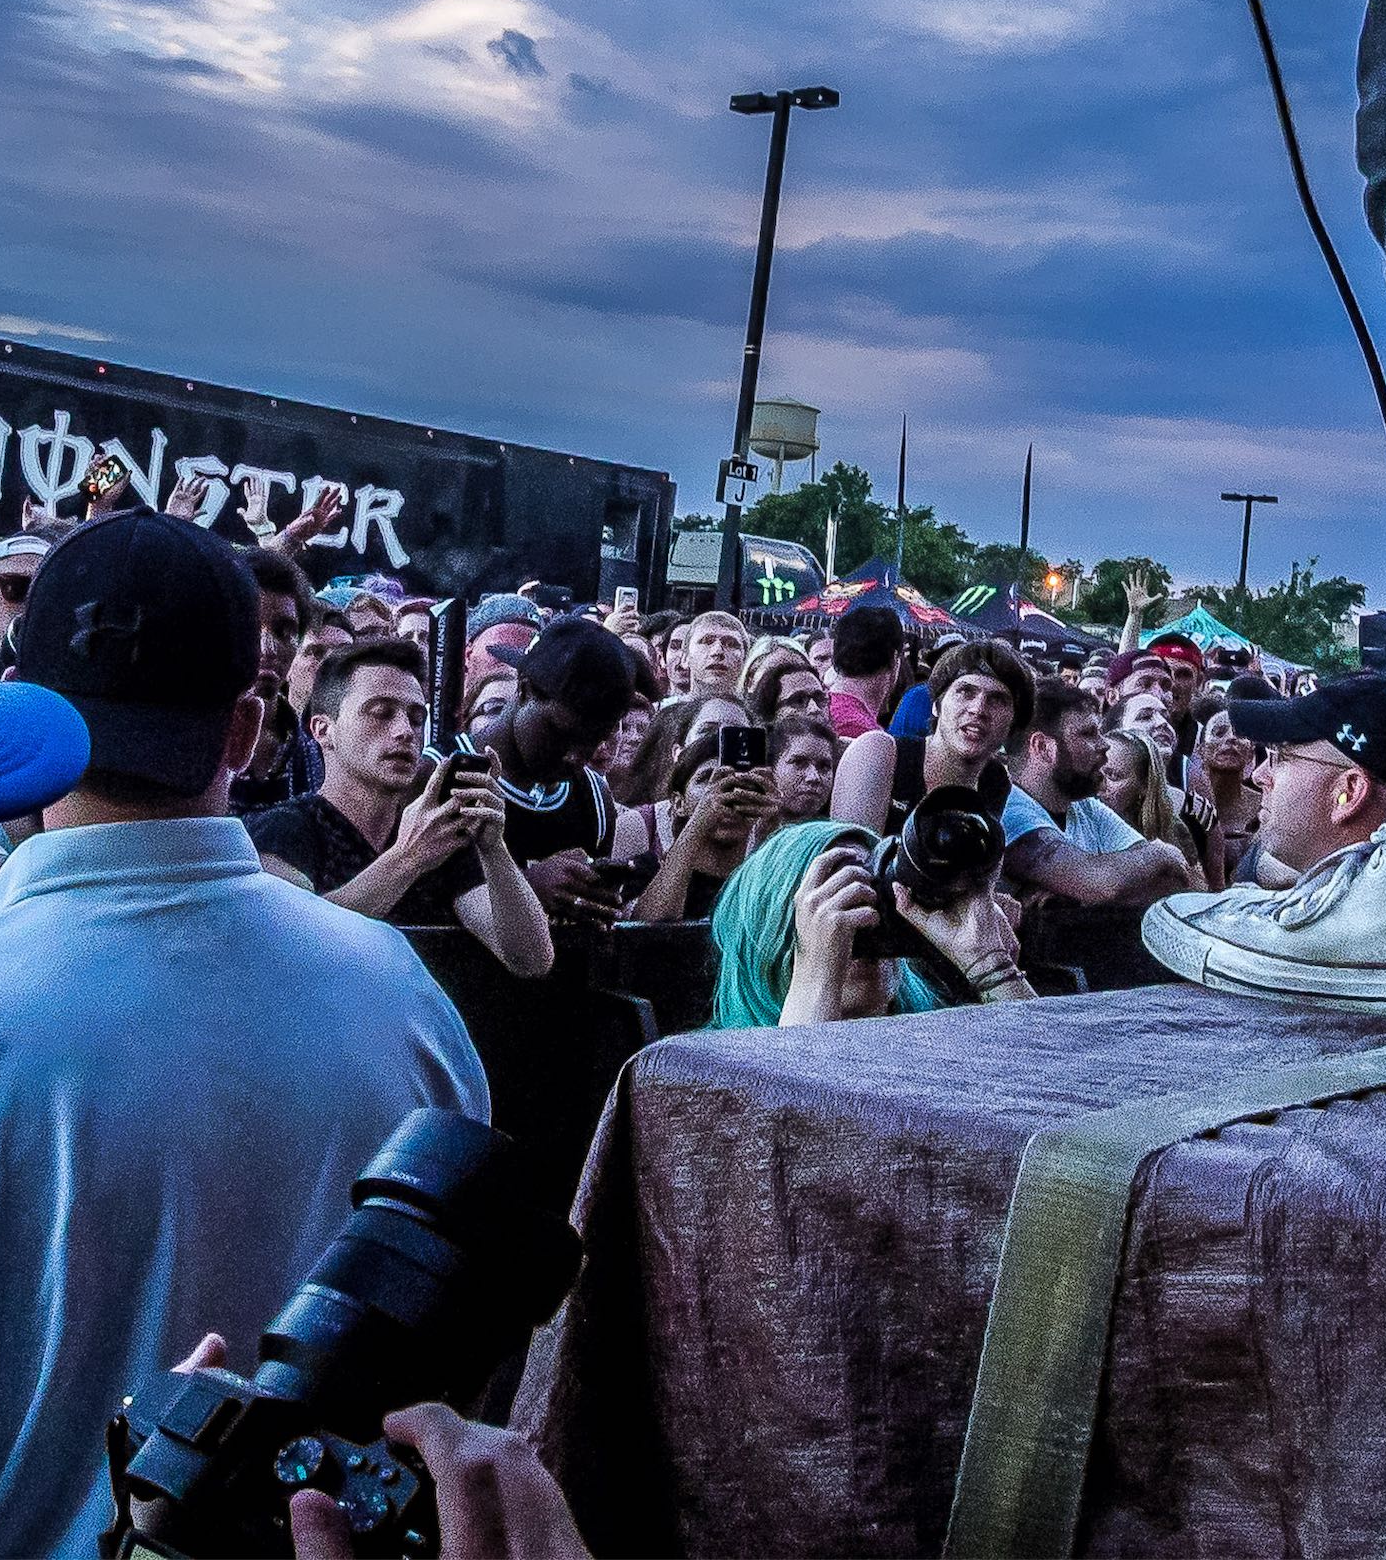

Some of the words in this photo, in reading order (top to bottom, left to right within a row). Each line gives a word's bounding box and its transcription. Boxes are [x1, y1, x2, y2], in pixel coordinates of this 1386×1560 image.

[728, 461, 748, 479] Lot
[751, 466, 757, 481] 1
[734, 481, 746, 503] J
